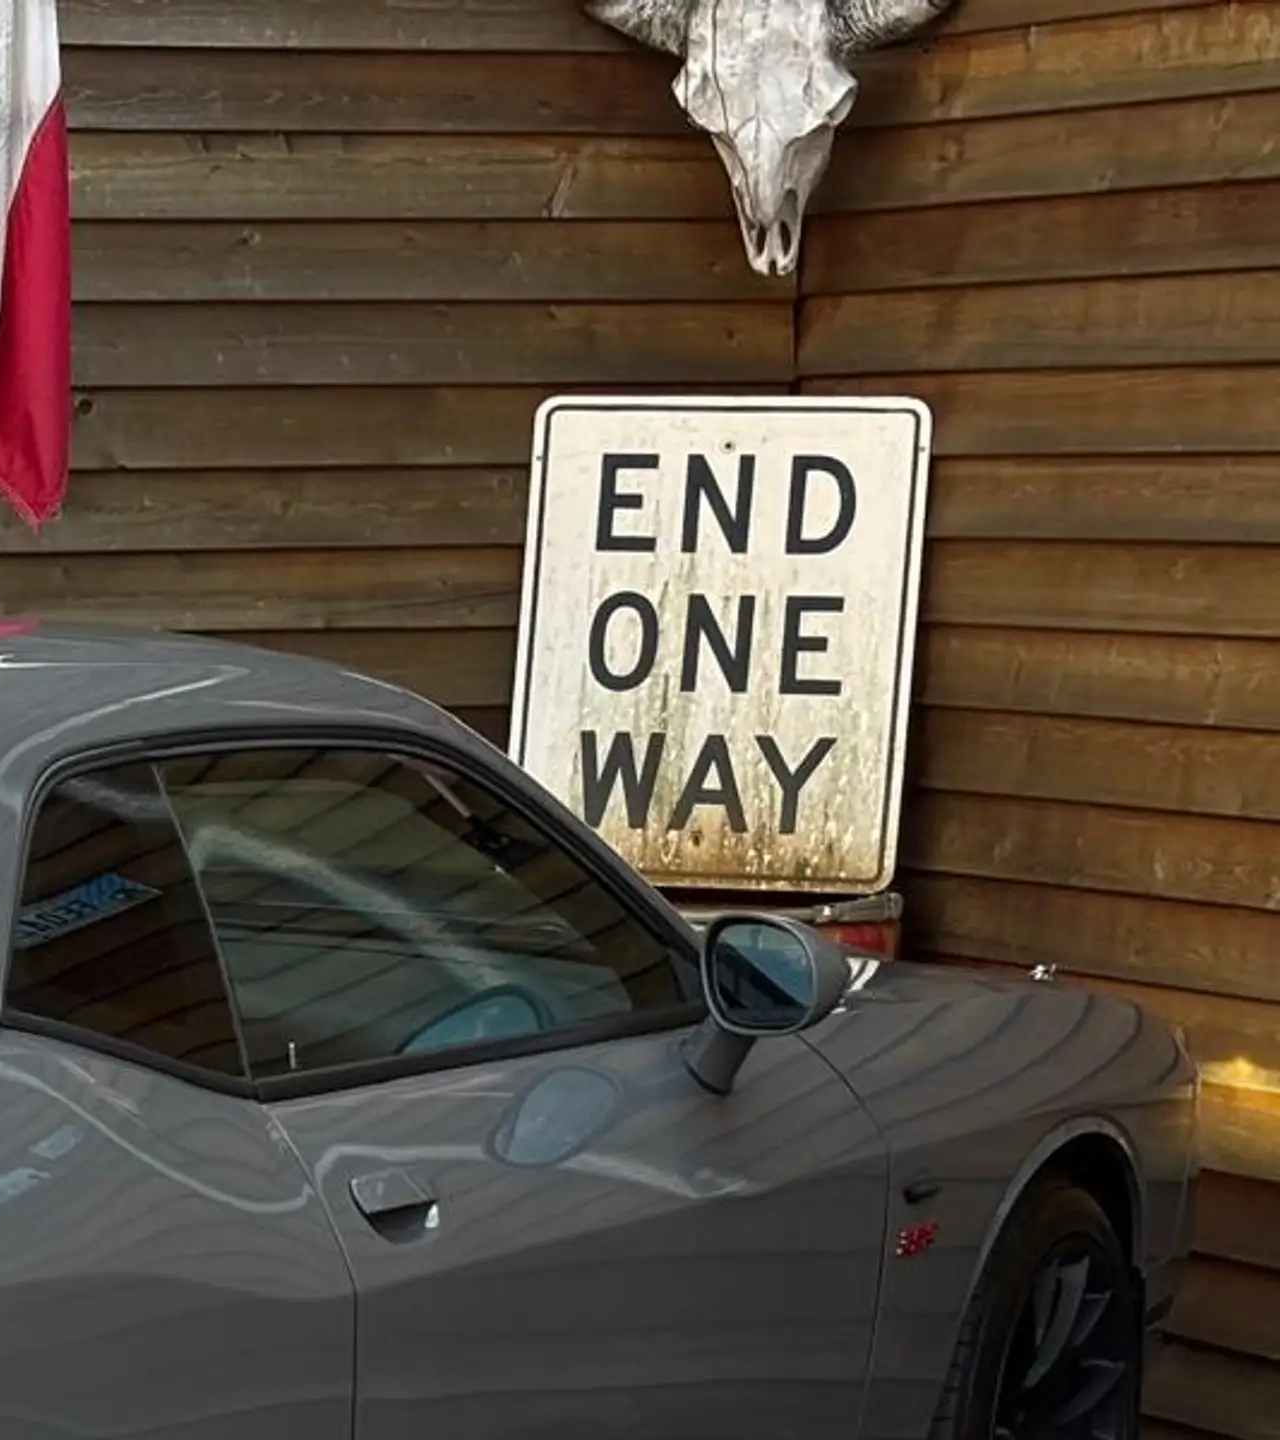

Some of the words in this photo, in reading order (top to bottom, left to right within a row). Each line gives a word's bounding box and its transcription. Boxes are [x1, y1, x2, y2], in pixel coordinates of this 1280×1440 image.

[594, 452, 858, 556] END
[587, 590, 846, 697] ONE
[579, 729, 839, 836] WAY
